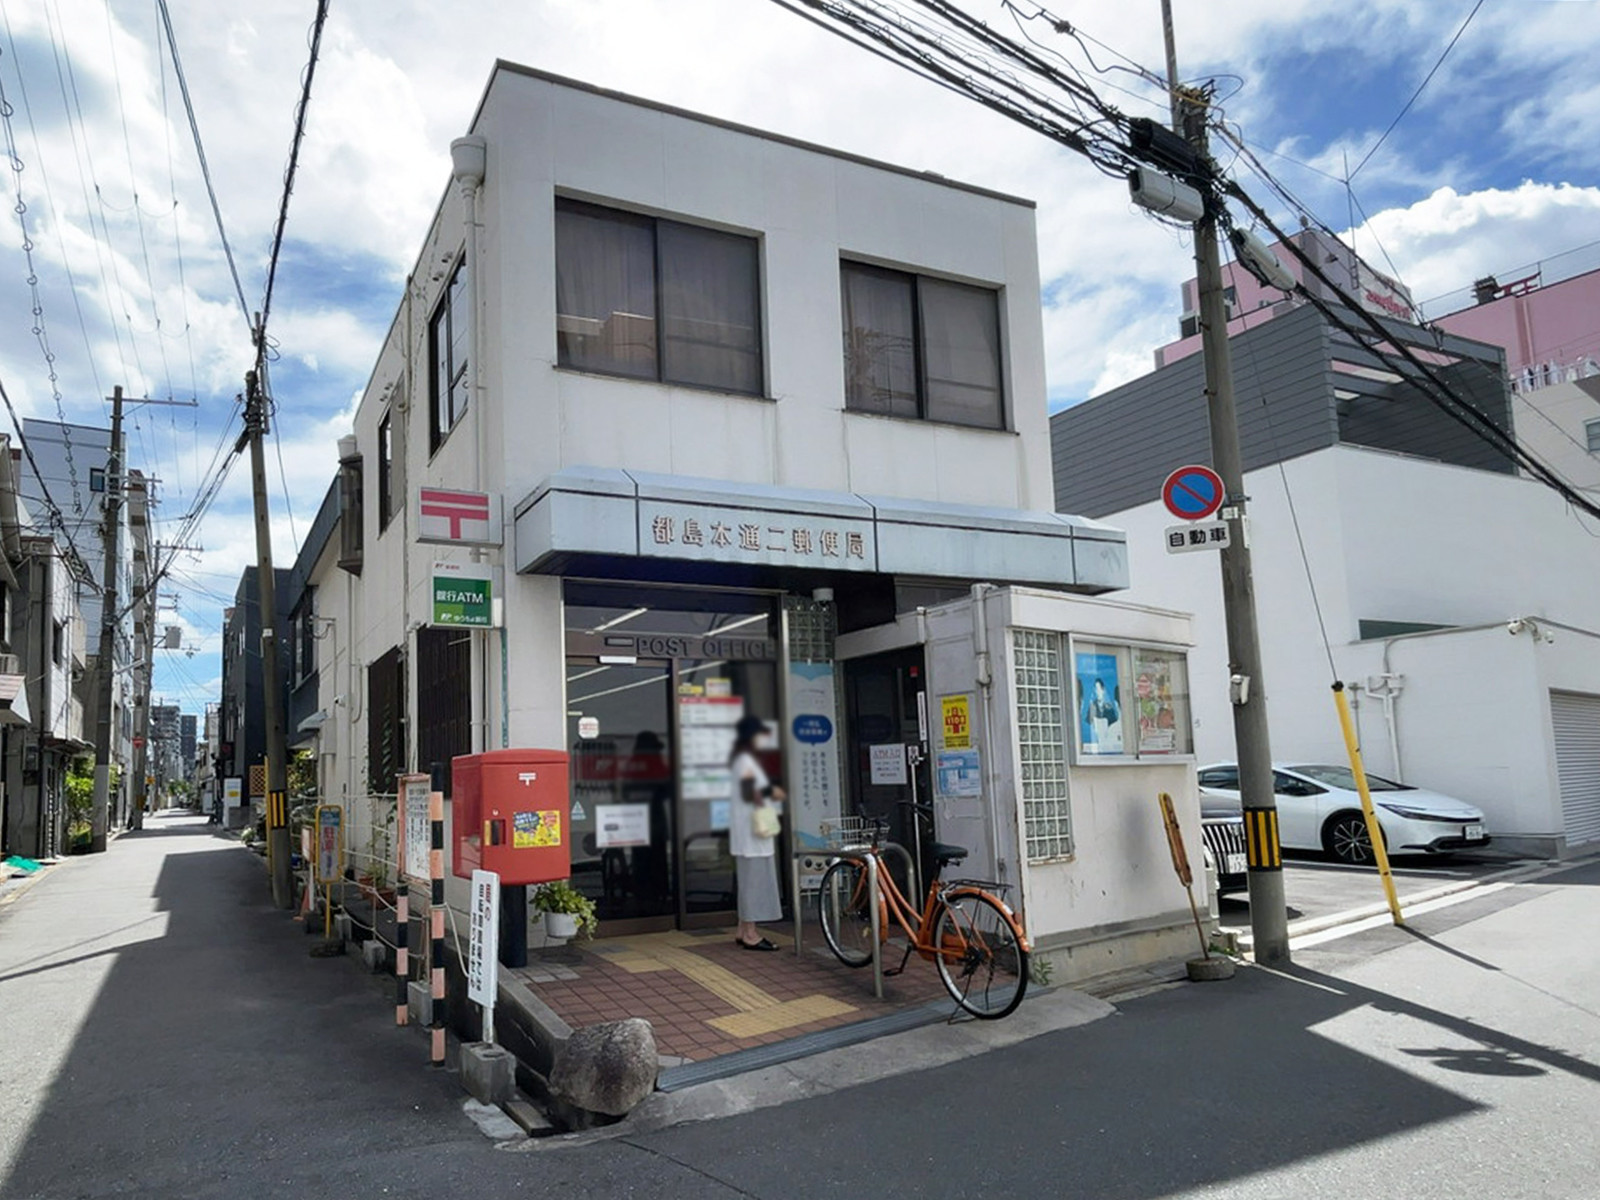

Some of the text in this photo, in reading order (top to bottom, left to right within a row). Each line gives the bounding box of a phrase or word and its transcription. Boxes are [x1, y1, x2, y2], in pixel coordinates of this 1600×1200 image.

[652, 514, 865, 559] 都島本通二郵便局
[1169, 527, 1227, 547] 自動車
[435, 589, 484, 604] 銀行ATM
[636, 637, 777, 658] POST OFFICE
